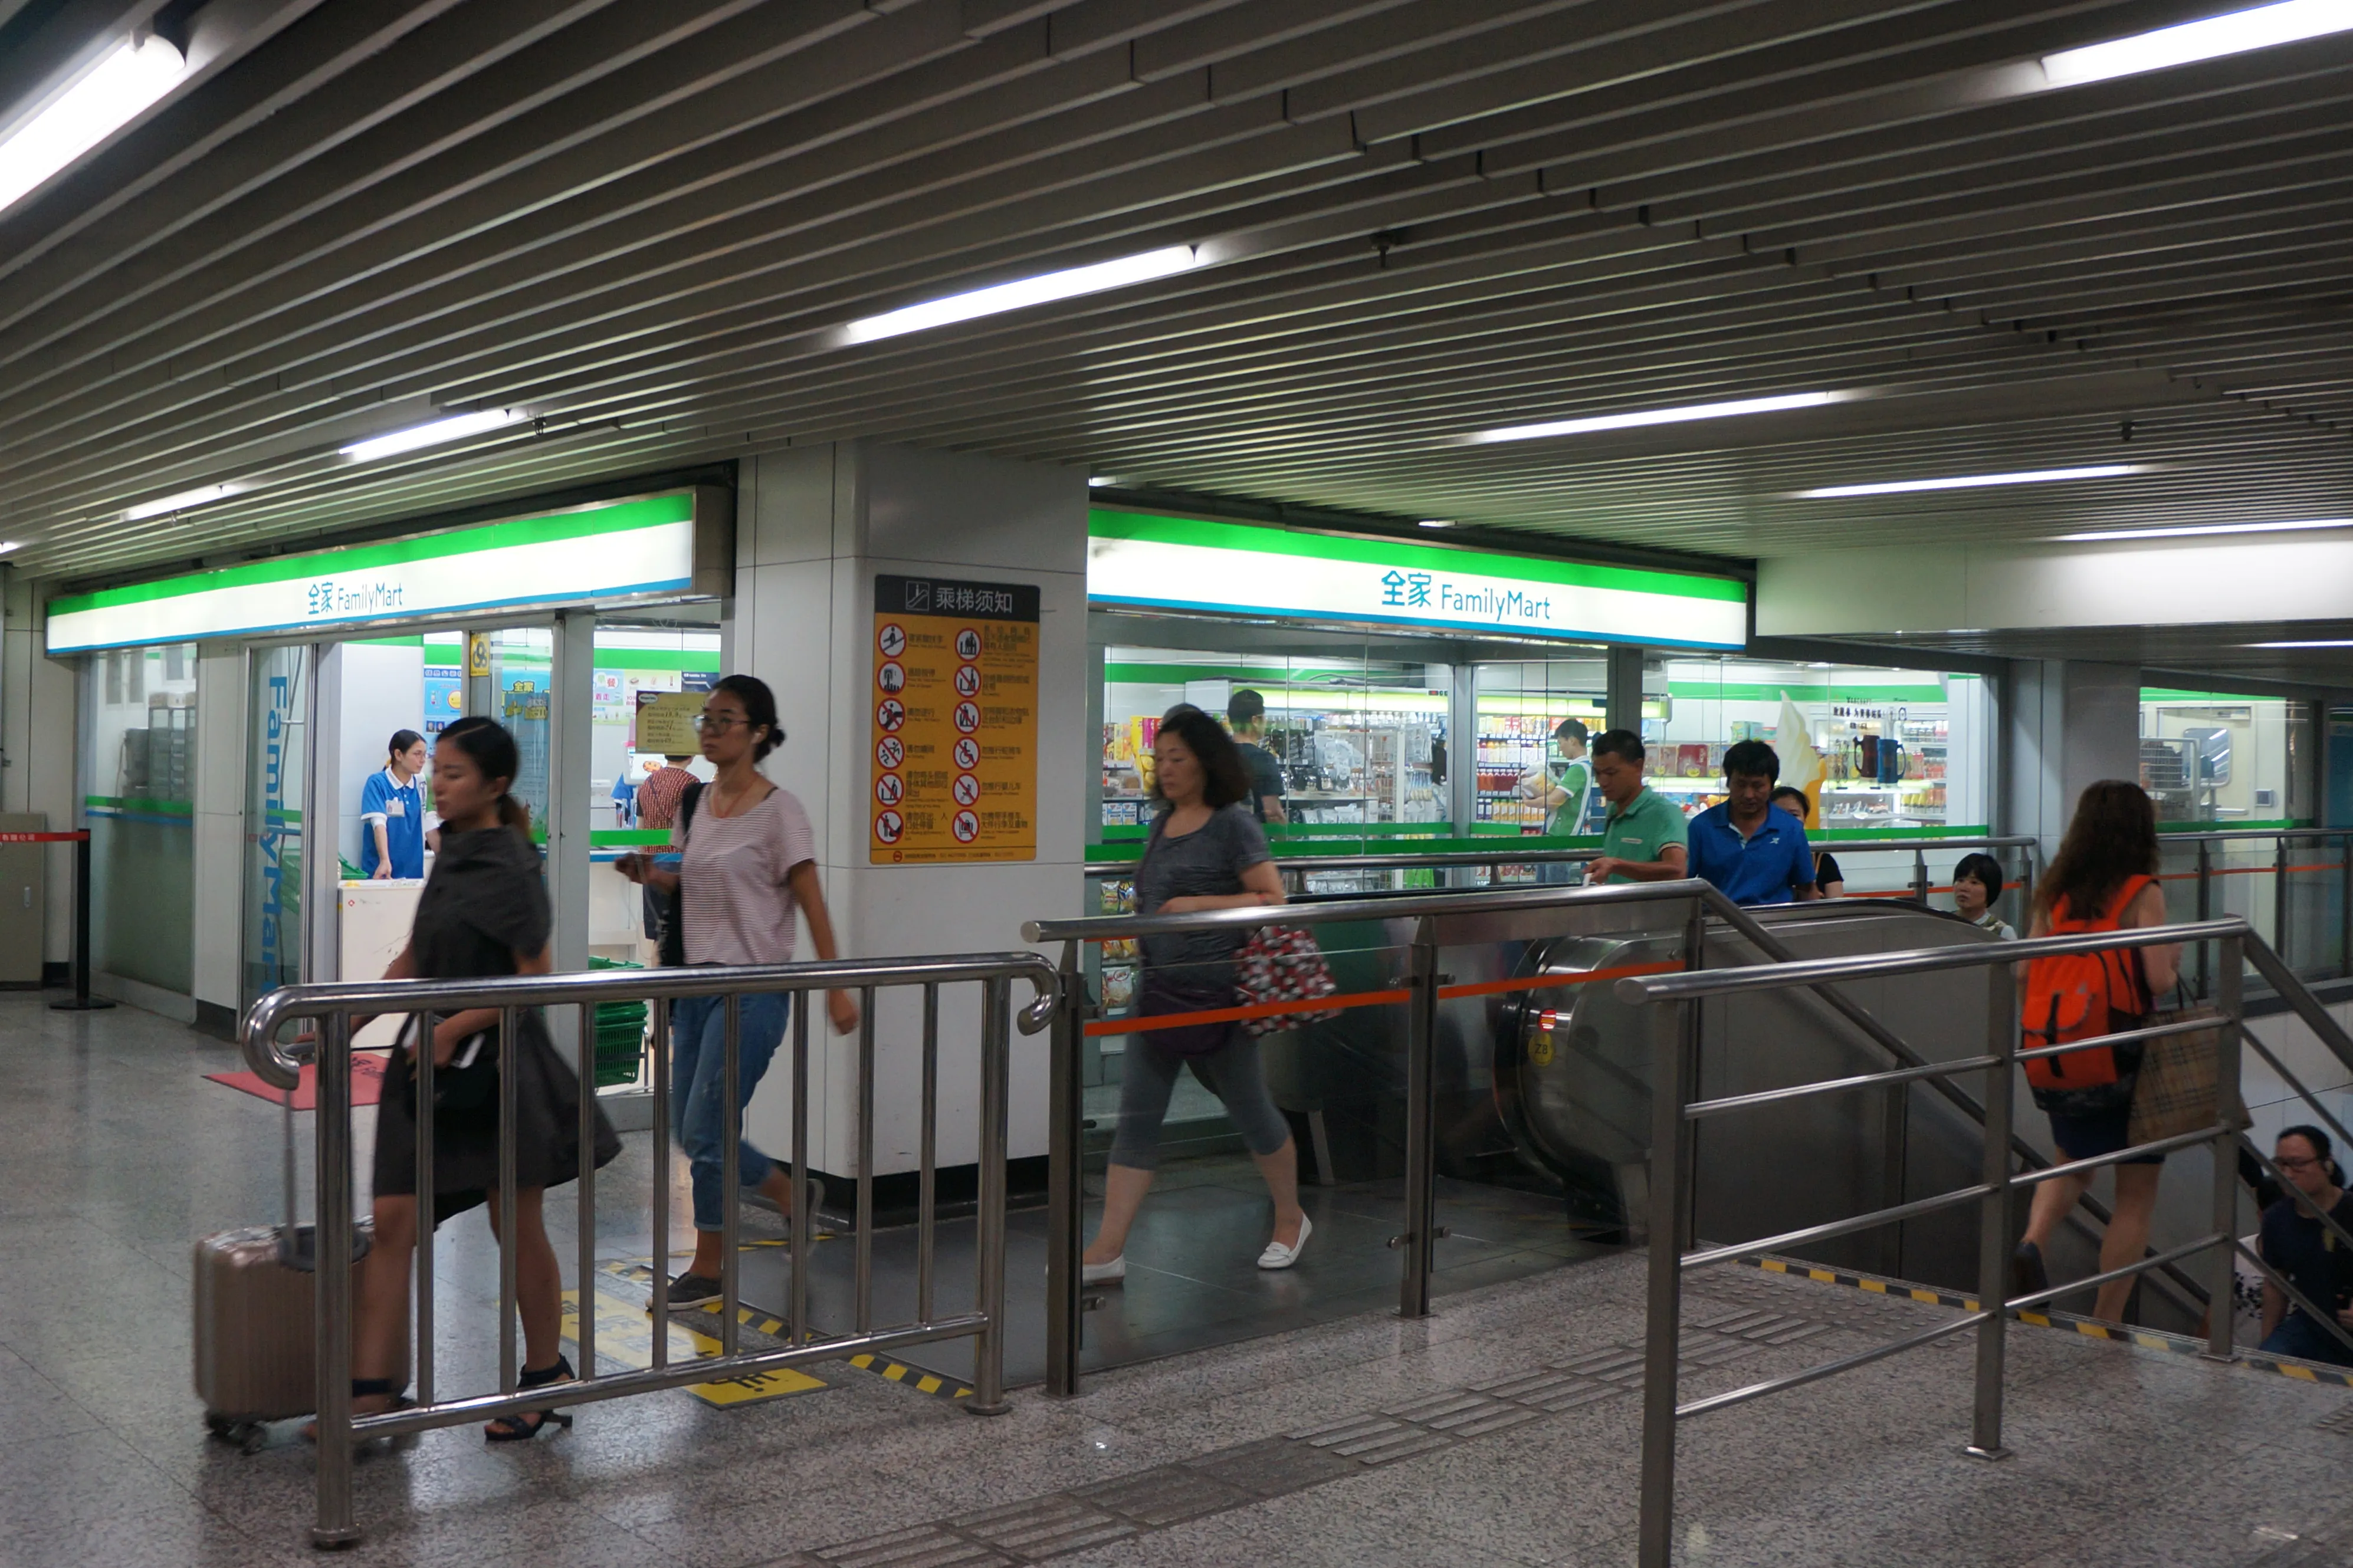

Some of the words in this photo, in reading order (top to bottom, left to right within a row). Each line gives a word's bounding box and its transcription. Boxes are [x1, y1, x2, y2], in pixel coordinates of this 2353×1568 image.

[308, 581, 333, 615] 全家
[338, 582, 403, 613] FamilyMart
[936, 587, 1013, 613] 乘梯须知
[1381, 570, 1432, 608] 全家
[1442, 584, 1551, 622] FamilyMart
